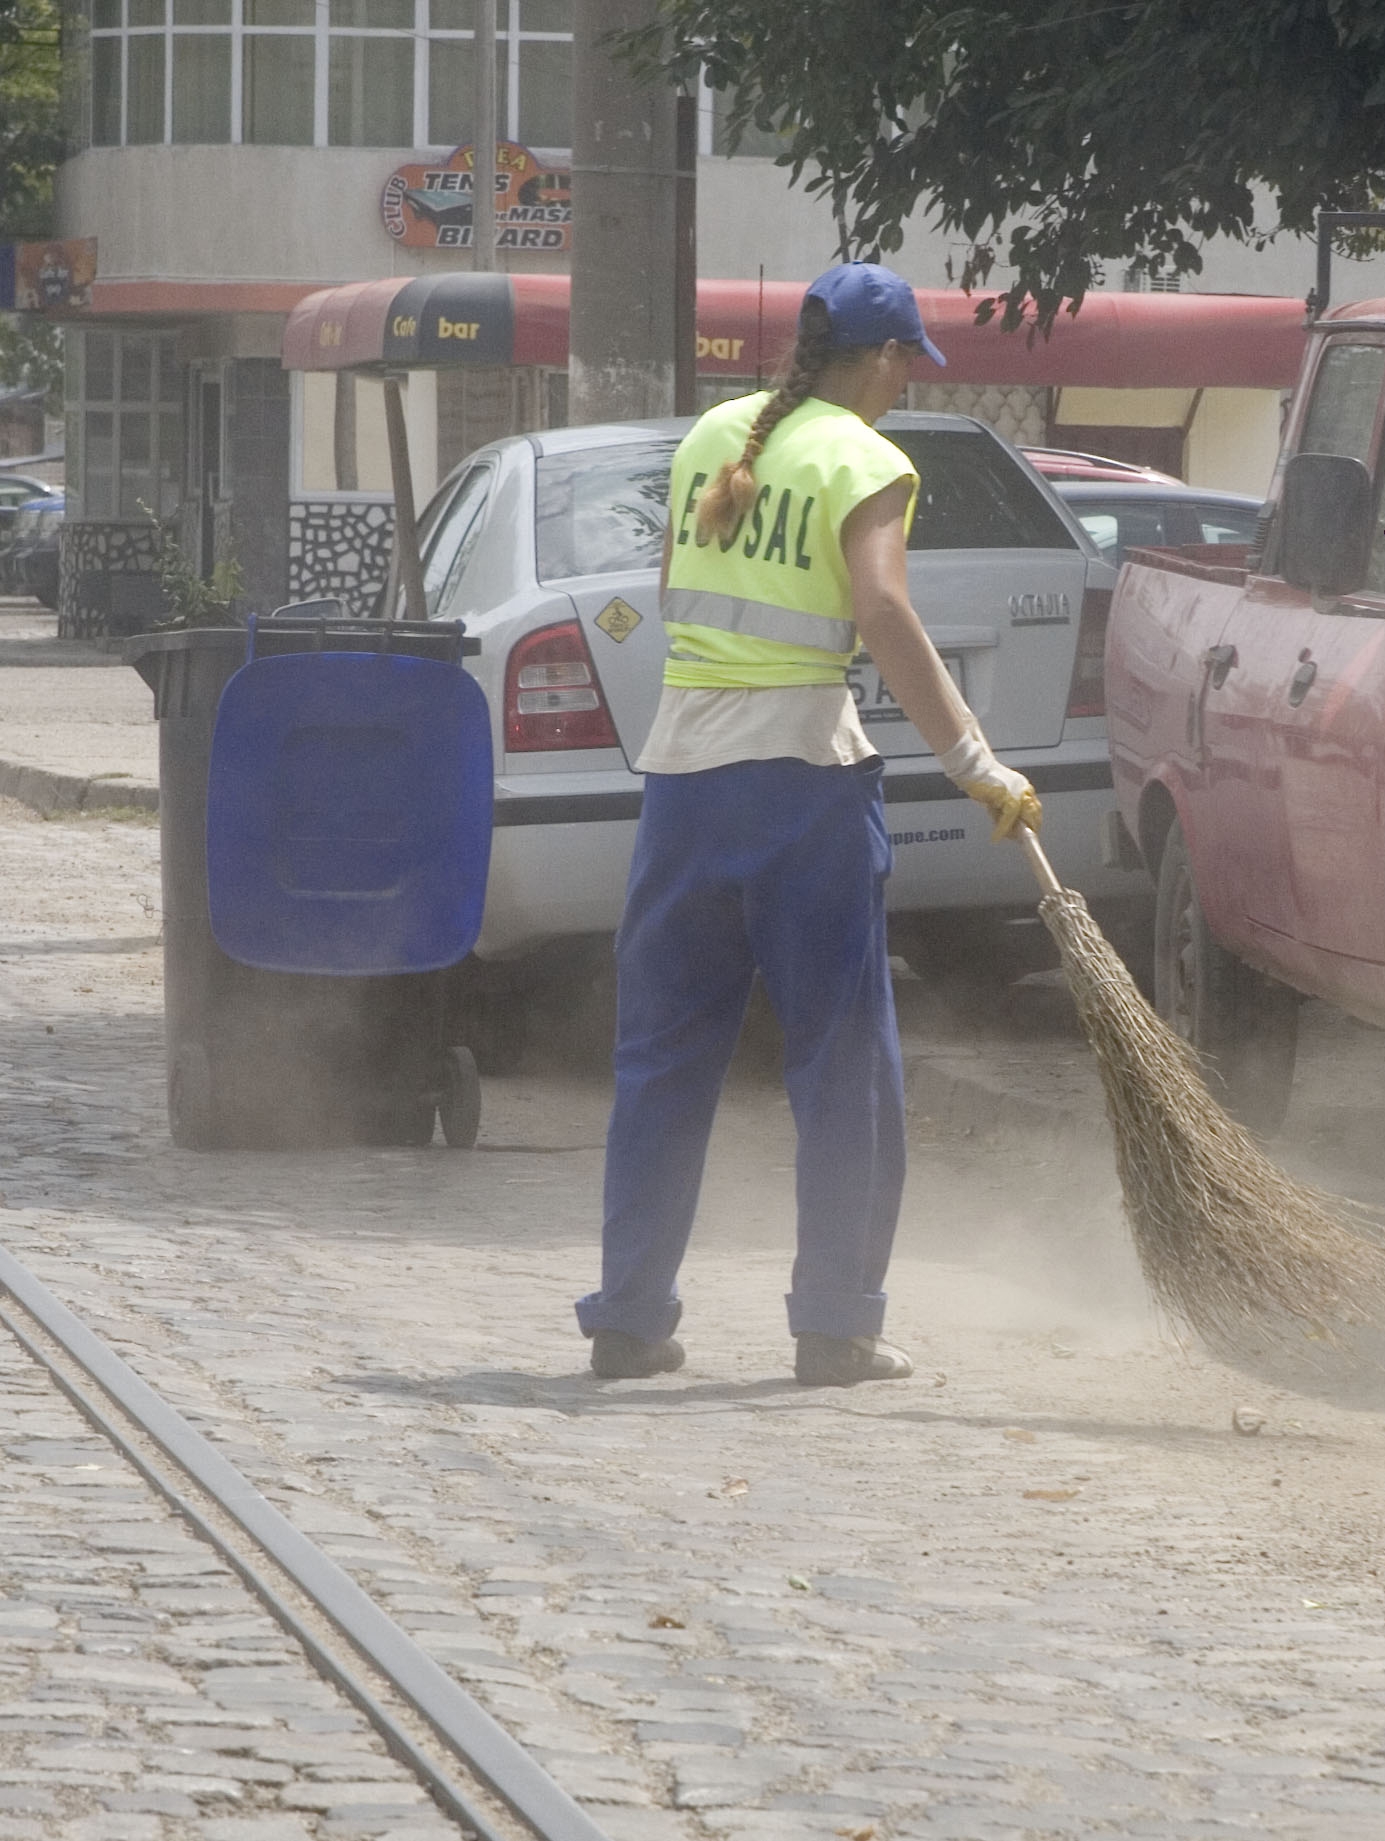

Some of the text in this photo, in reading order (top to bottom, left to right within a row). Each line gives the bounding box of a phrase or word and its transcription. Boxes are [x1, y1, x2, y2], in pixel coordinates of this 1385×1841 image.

[425, 173, 510, 192] TENS
[385, 177, 408, 238] CLUB
[437, 228, 563, 247] BIARD
[438, 317, 480, 340] bar
[696, 331, 744, 360] bar
